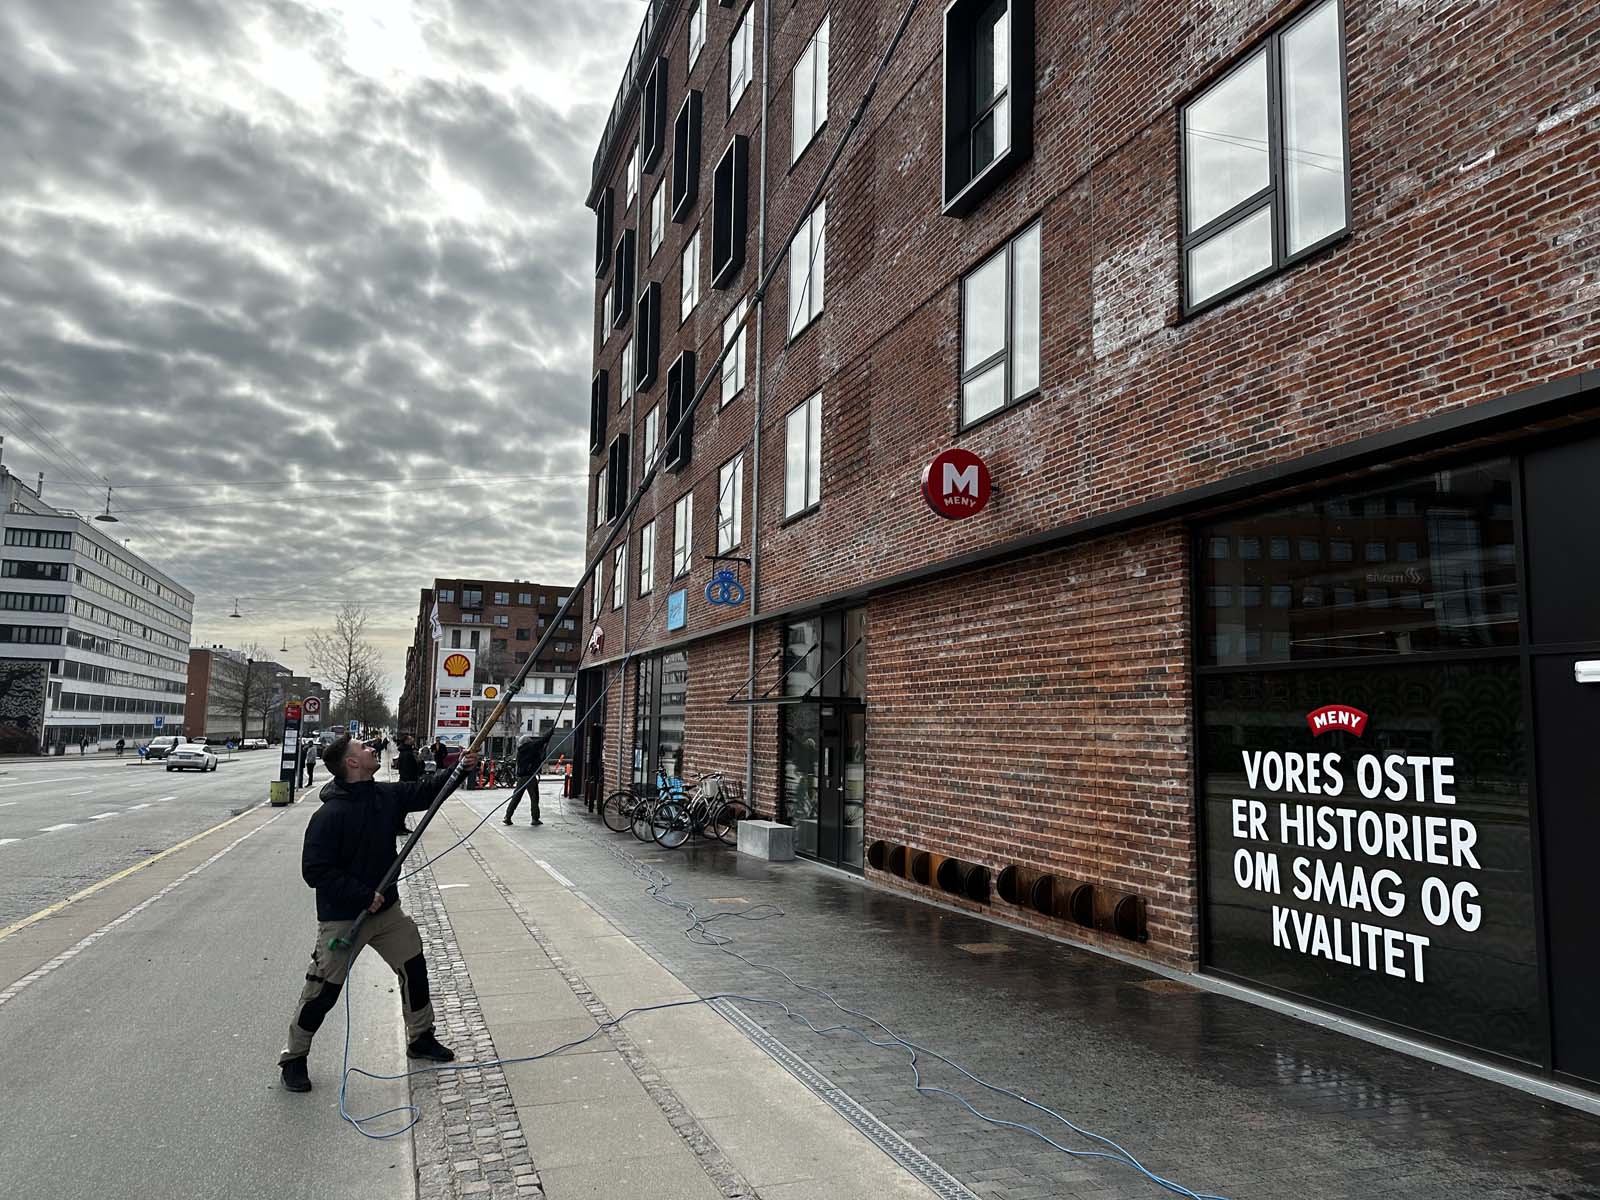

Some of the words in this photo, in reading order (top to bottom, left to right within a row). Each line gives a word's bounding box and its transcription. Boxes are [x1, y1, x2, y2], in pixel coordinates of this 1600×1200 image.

[943, 463, 978, 498] M
[944, 496, 977, 508] MENY
[1313, 710, 1361, 729] MENY
[1242, 750, 1344, 797] VORES
[1356, 753, 1456, 805] OSTE
[1232, 798, 1270, 842] ER
[1279, 802, 1482, 870] HISTORIER
[1233, 848, 1281, 895] OM
[1292, 856, 1406, 918] SMAG
[1421, 876, 1482, 932] OG
[1272, 905, 1430, 983] KVALITET
